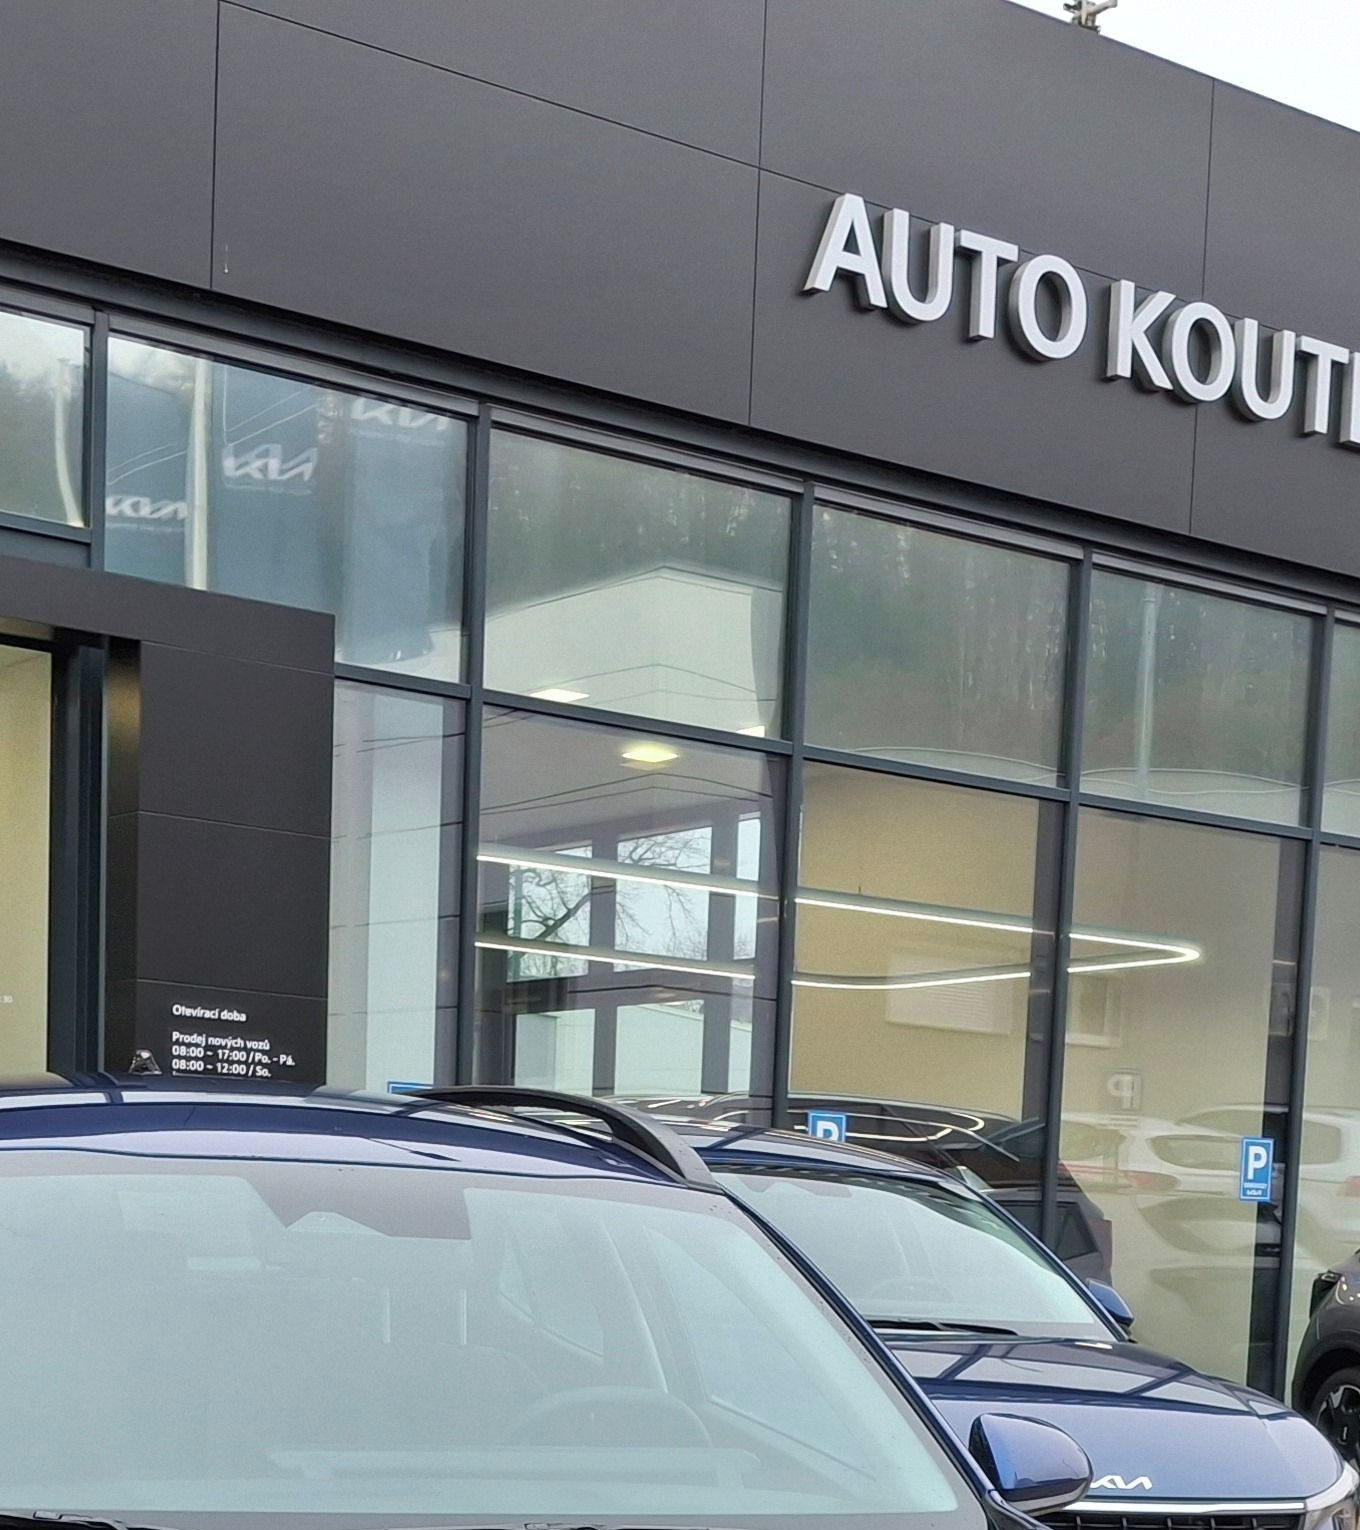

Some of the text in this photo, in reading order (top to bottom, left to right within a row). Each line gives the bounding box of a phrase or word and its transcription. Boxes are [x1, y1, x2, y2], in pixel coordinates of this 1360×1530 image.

[802, 192, 1087, 361] AUTO
[172, 1004, 247, 1021] Otevírací doba
[172, 1031, 270, 1050] Prodej nových vozů
[172, 1045, 204, 1057] 08:00
[217, 1049, 246, 1061] 17:00
[172, 1059, 204, 1071] 08:00
[216, 1062, 246, 1075] 12:00
[256, 1066, 271, 1077] So.
[1247, 1145, 1267, 1180] P
